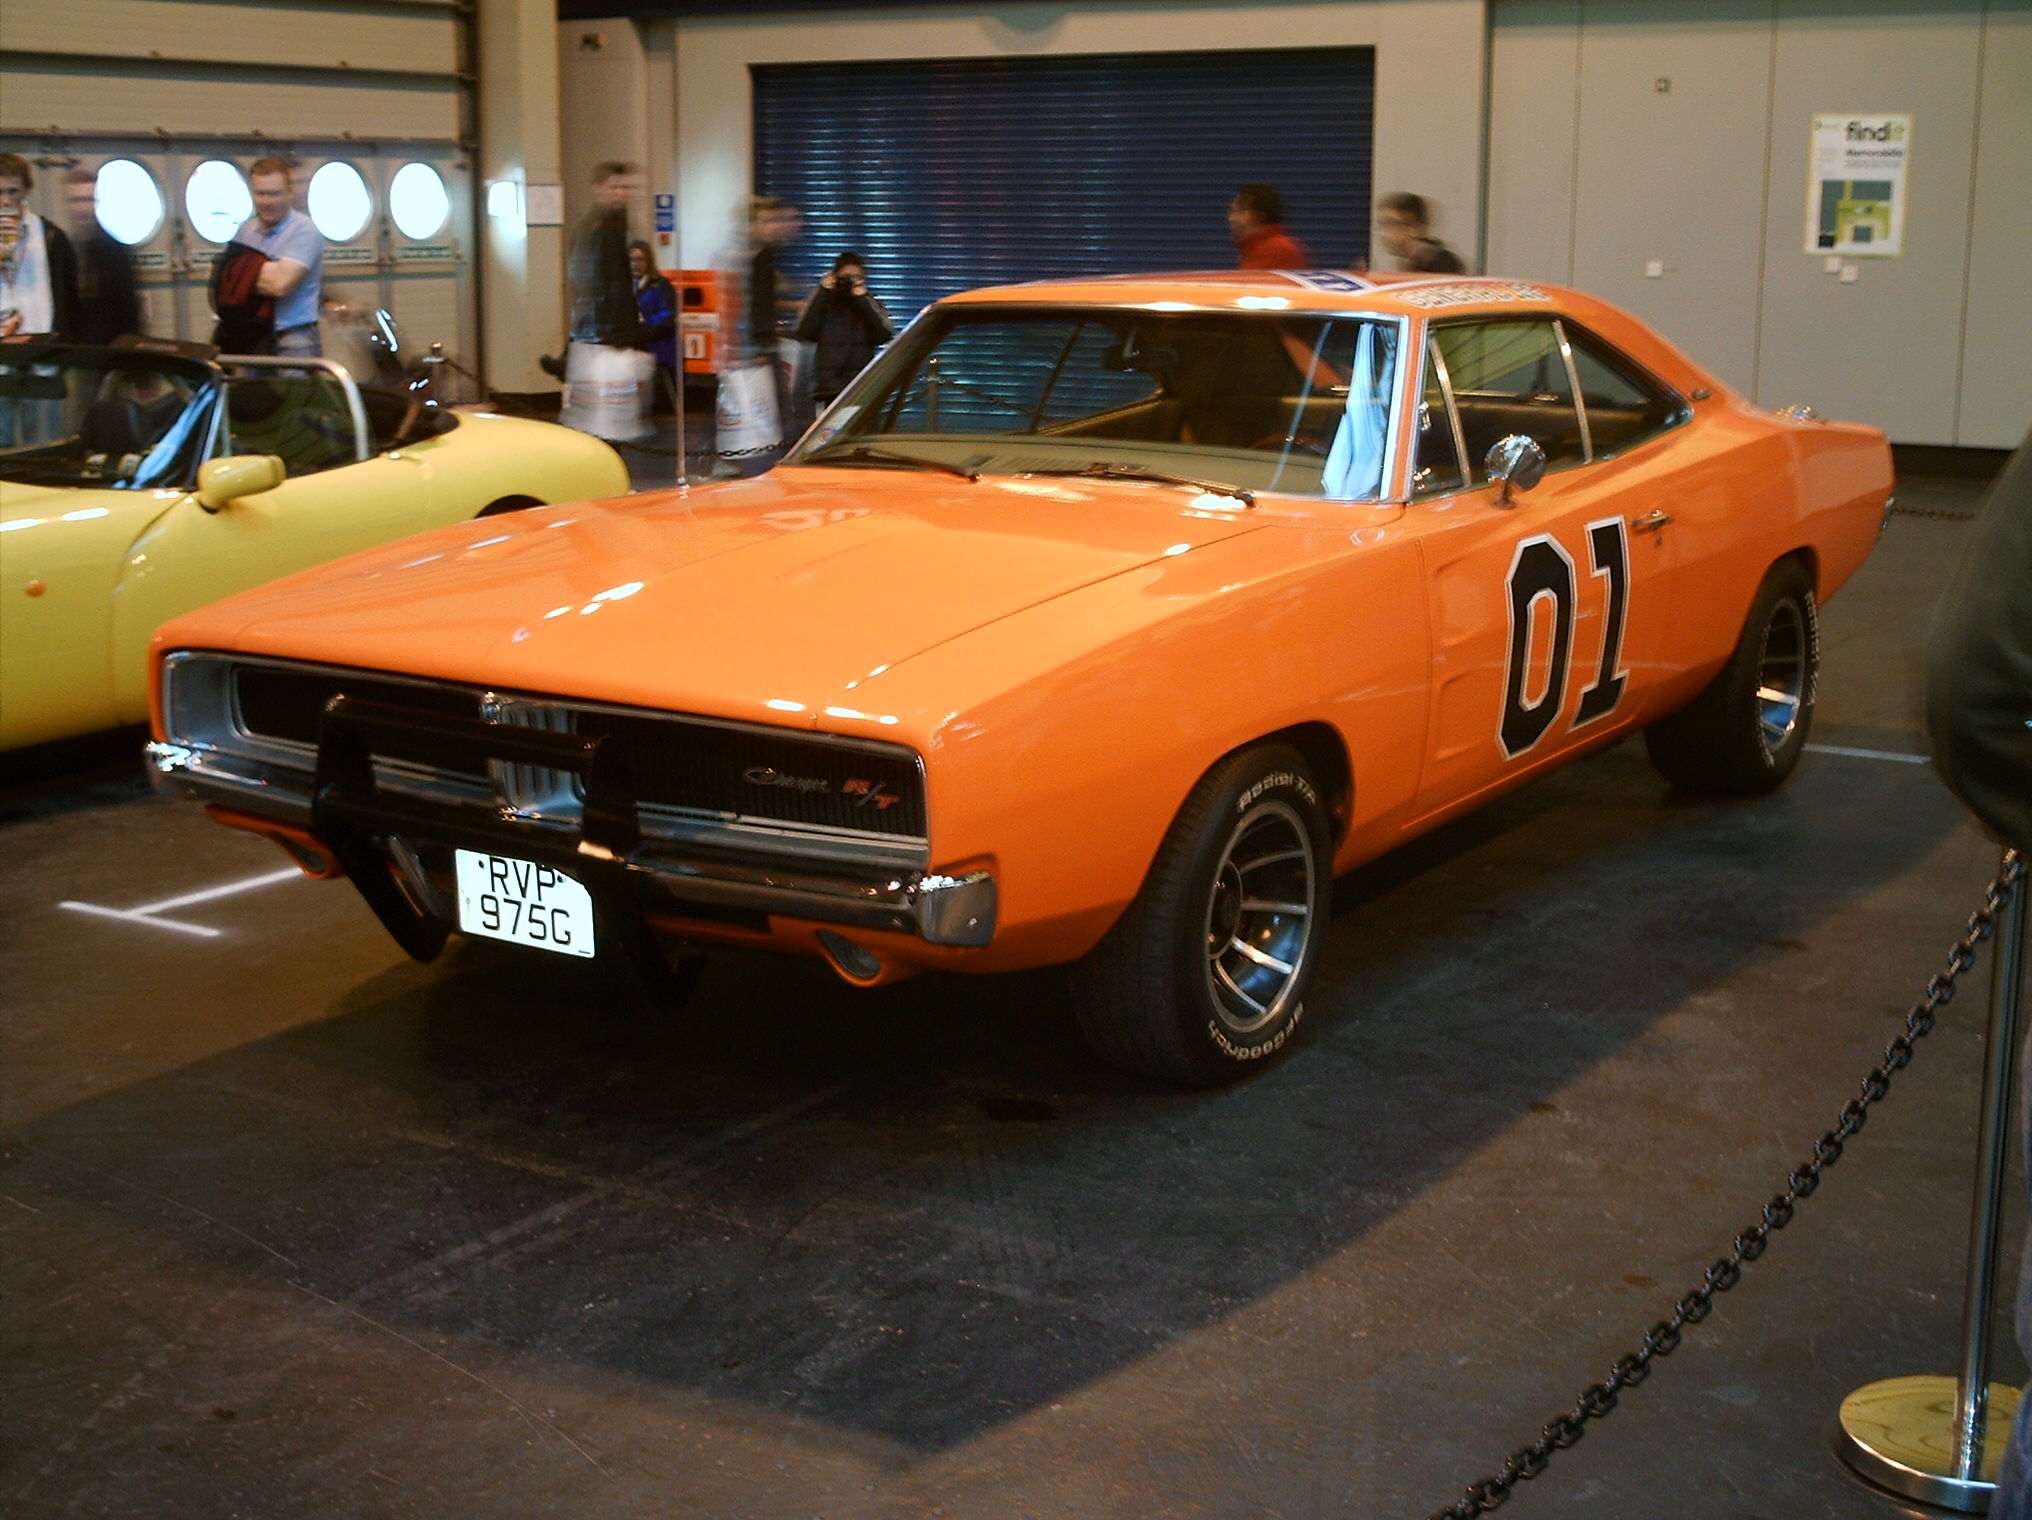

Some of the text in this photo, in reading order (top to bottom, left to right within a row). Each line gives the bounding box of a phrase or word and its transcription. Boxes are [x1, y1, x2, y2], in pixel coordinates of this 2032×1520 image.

[1495, 514, 1631, 761] 01
[489, 856, 556, 901] RVP
[481, 893, 571, 945] 975G
